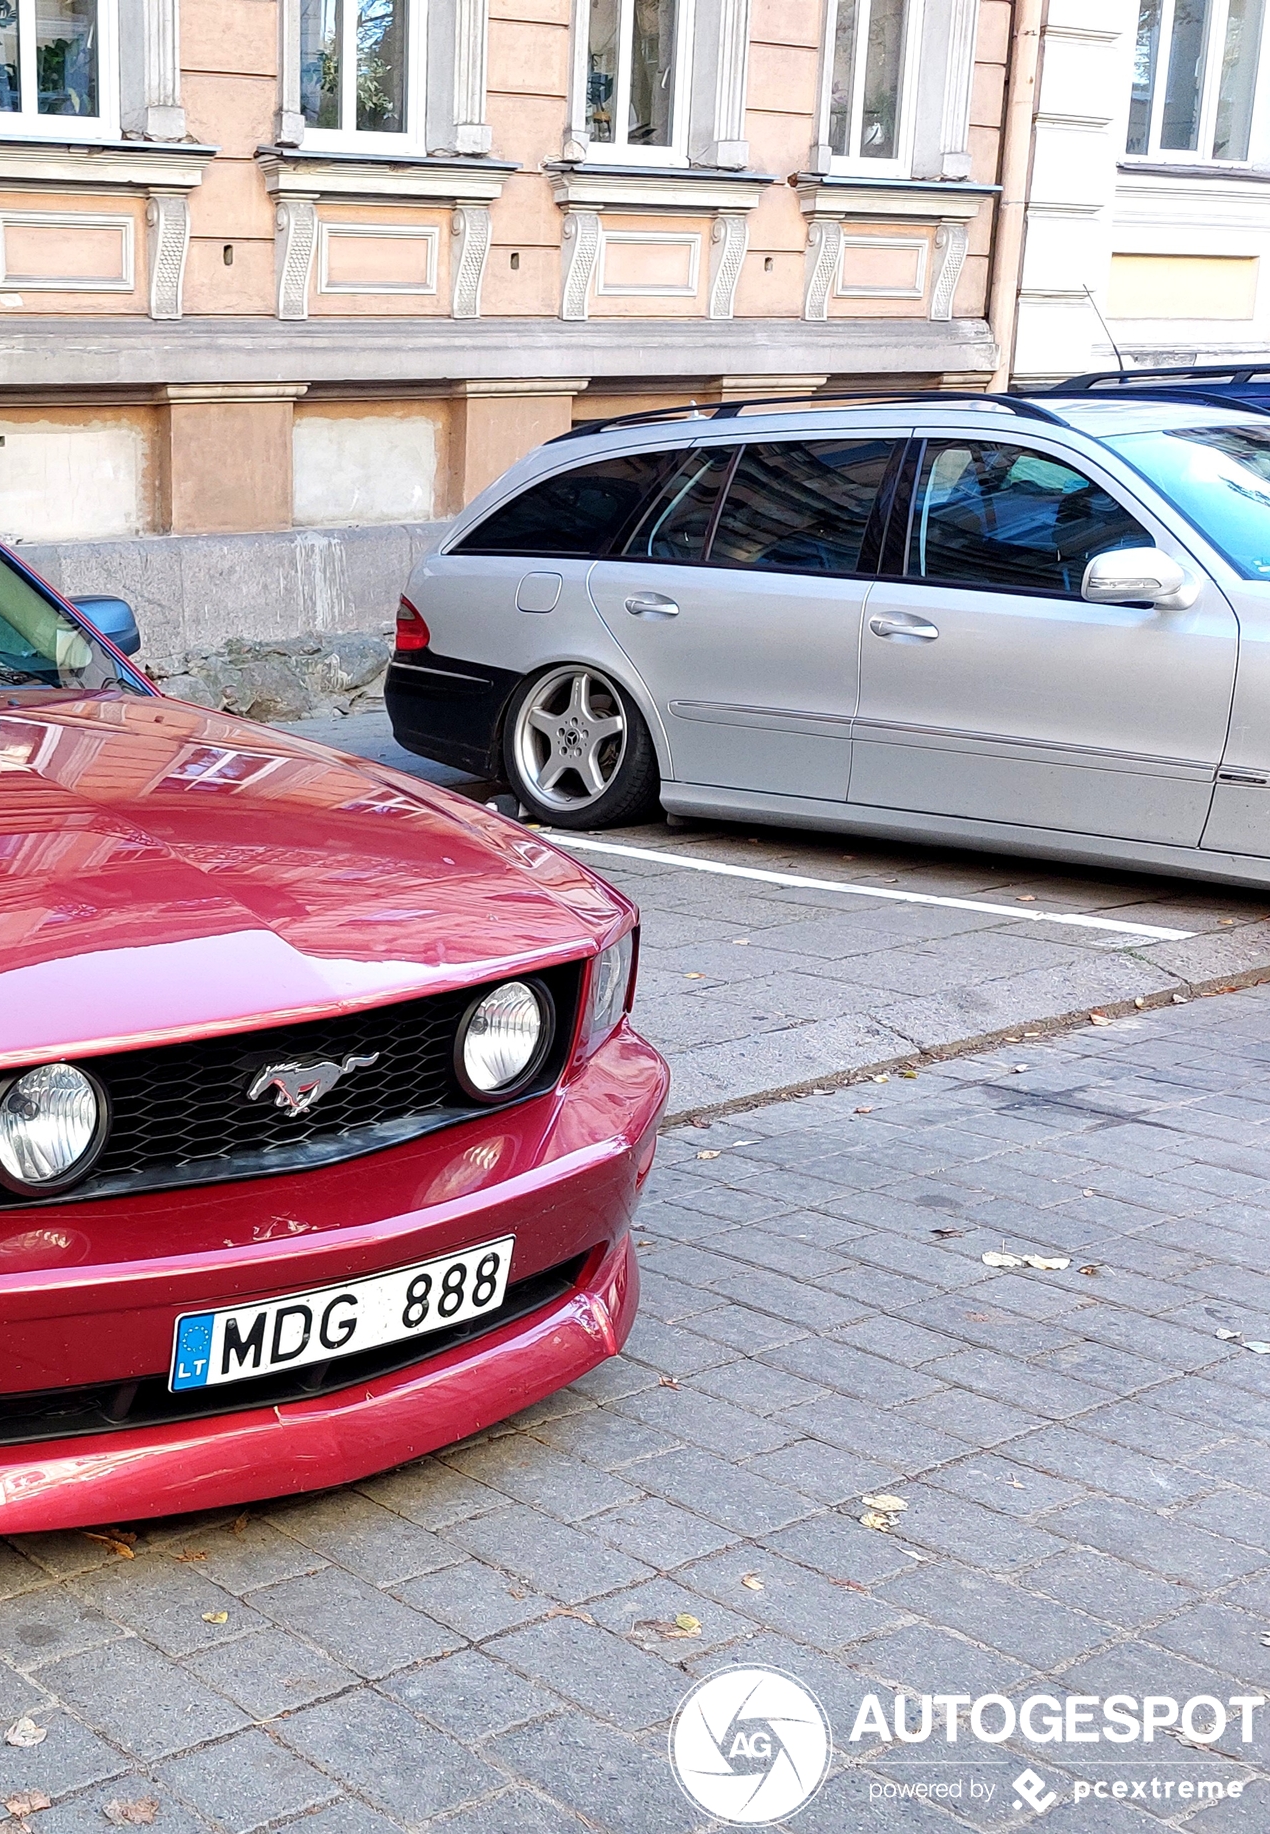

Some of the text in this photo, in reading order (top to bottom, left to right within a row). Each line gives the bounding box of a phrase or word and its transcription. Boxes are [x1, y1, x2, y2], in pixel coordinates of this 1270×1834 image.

[220, 1251, 501, 1375] MDG 888
[177, 1358, 207, 1379] LT
